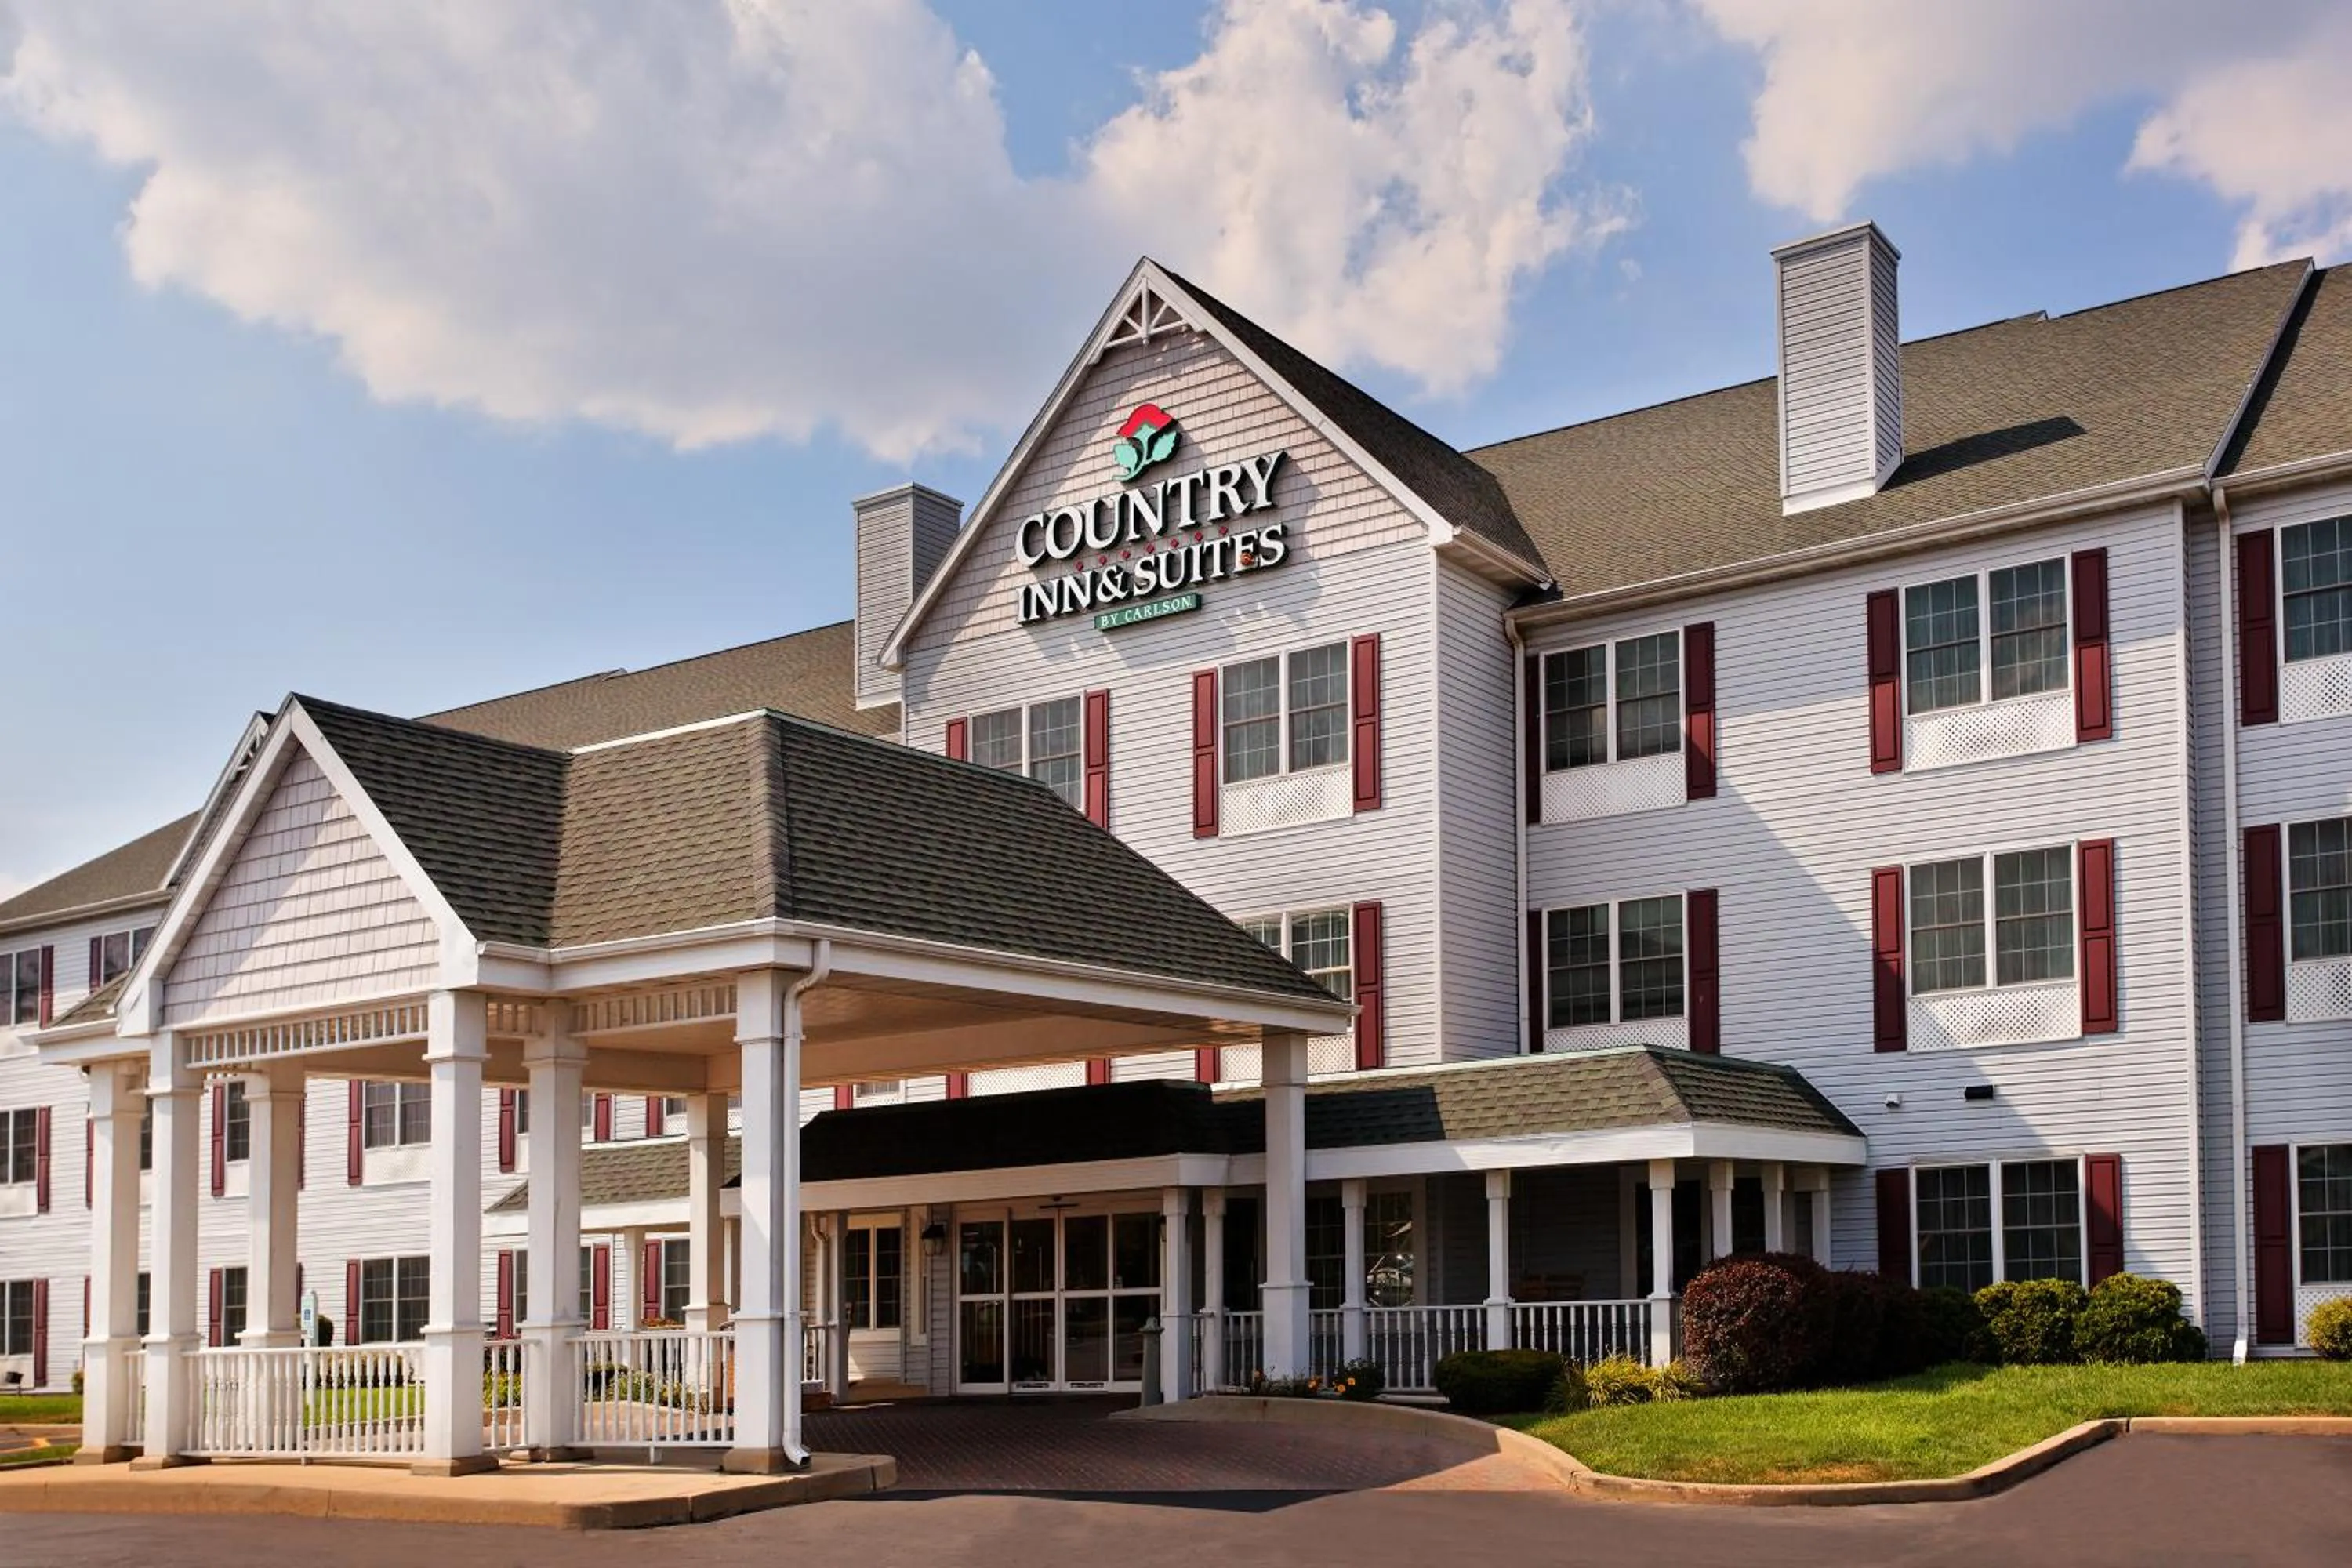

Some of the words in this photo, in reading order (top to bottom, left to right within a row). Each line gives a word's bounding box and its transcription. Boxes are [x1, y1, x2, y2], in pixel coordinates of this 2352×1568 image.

[1015, 451, 1287, 568] COUNTRY
[1101, 613, 1118, 626] BY
[1124, 596, 1192, 622] CARLSON
